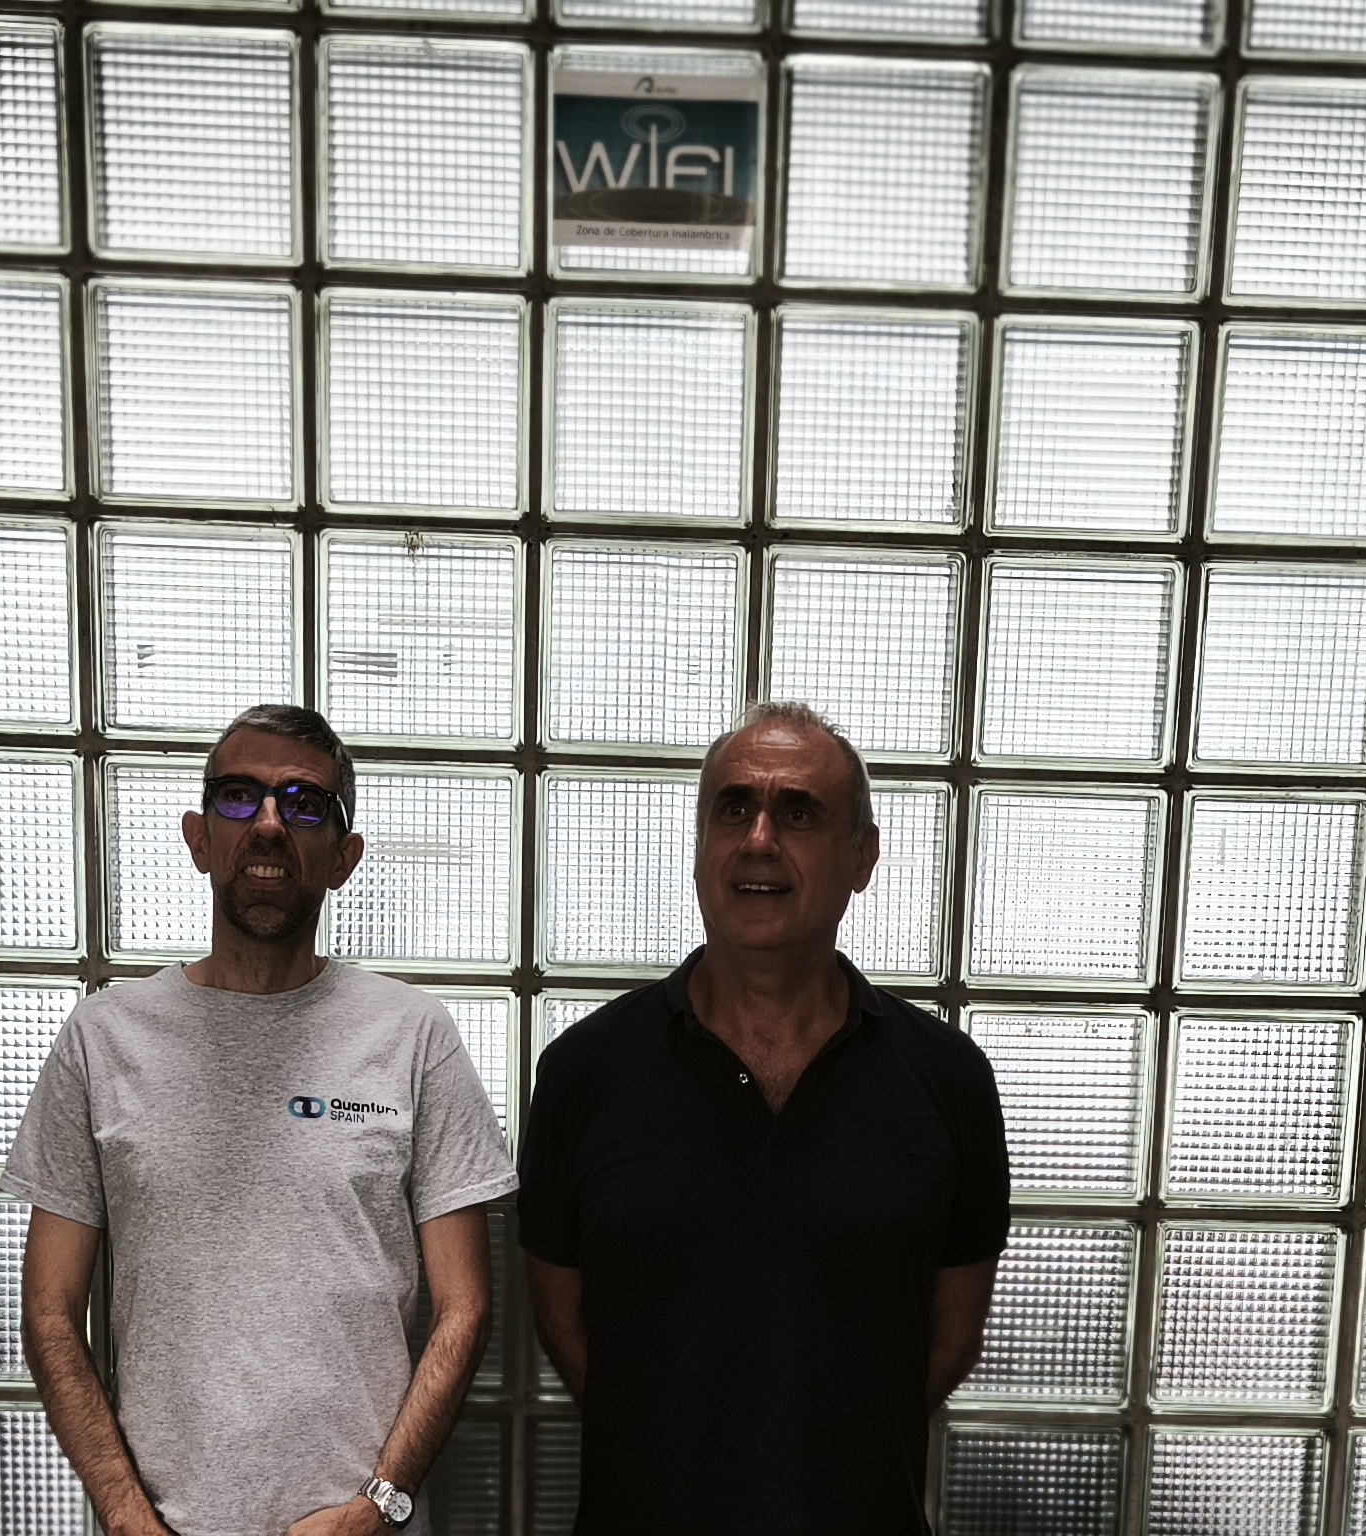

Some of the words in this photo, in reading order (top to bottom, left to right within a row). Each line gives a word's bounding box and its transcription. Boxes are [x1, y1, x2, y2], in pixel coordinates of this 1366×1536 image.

[576, 224, 600, 236] Zona
[604, 225, 616, 236] de
[619, 226, 669, 239] Cobertura
[330, 1111, 365, 1123] SPAIN
